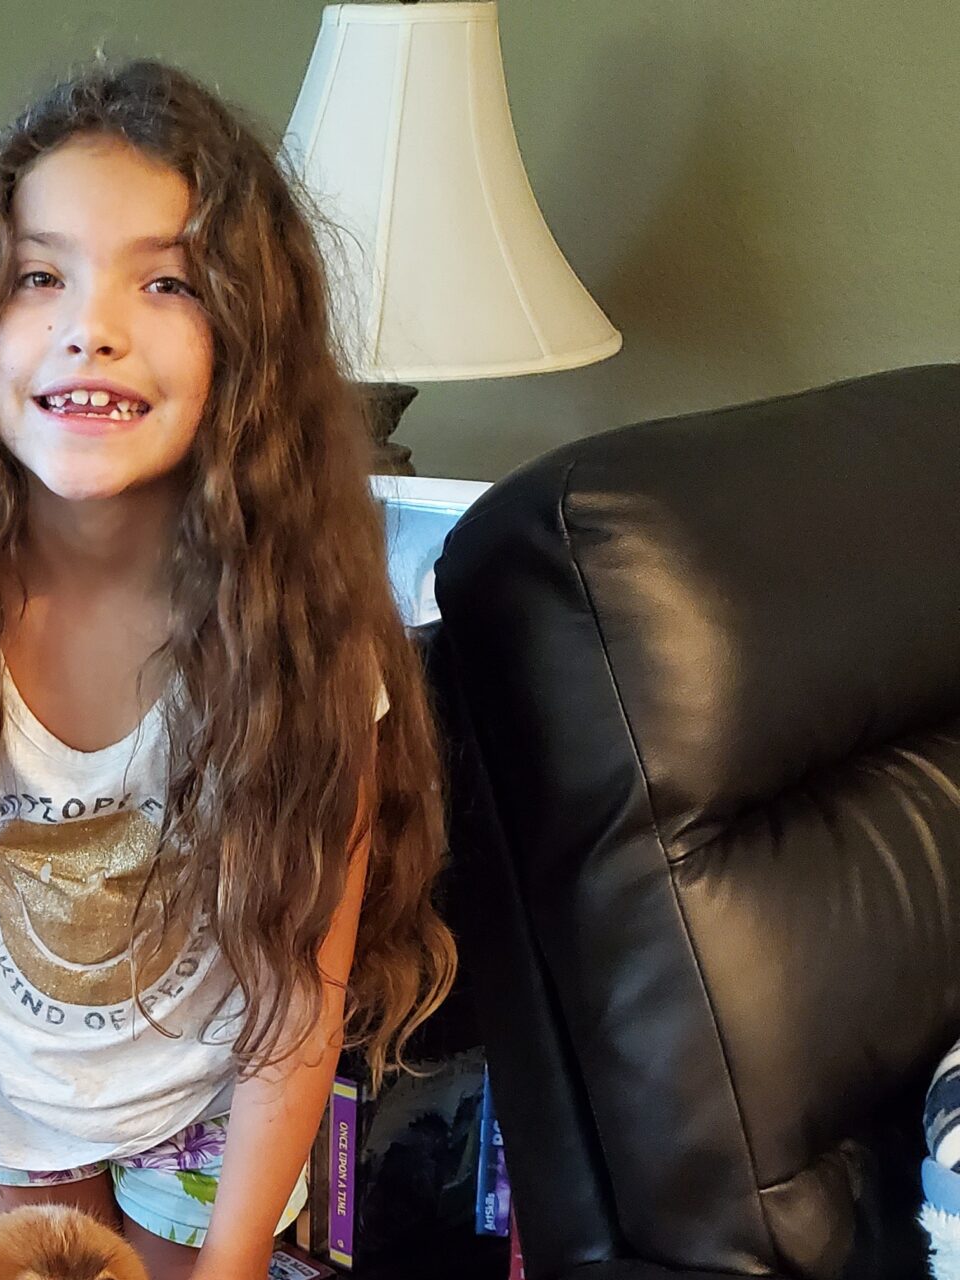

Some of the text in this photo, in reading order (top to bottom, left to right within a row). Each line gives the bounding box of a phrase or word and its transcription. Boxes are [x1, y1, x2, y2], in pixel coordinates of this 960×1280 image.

[84, 1008, 127, 1032] OF
[337, 1121, 349, 1217] ONCE UPON A TIME
[484, 1192, 496, 1232] ArtSkills
